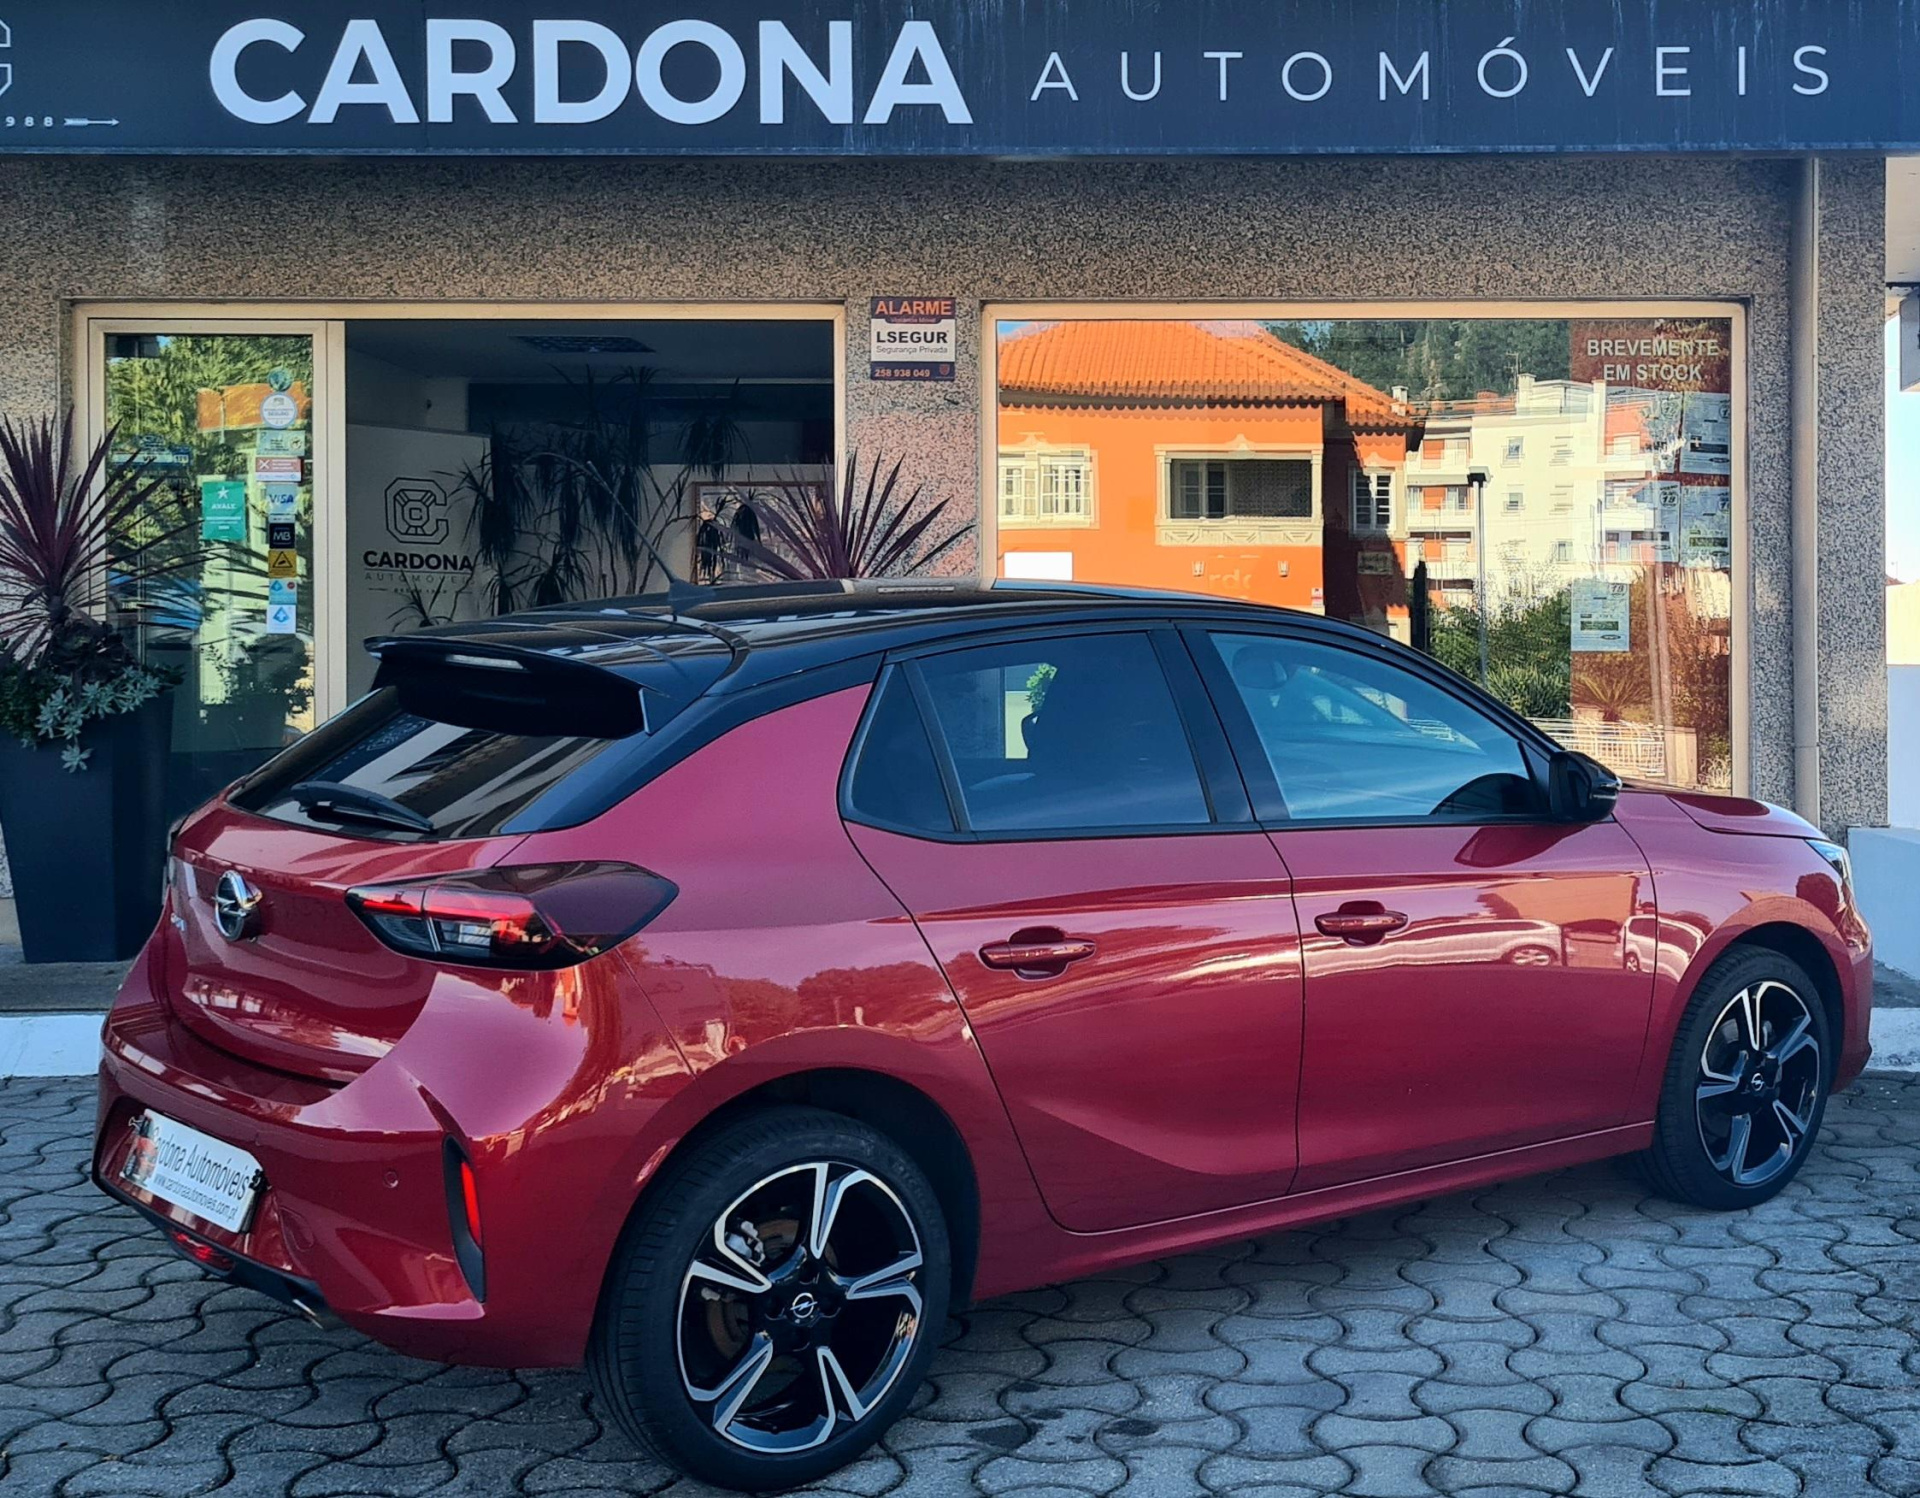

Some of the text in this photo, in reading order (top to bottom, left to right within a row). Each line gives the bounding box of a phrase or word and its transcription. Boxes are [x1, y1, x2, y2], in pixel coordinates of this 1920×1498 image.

[210, 18, 1829, 125] CARDONA AUTOMÓVEIS
[875, 300, 952, 315] ALARME
[876, 331, 948, 344] LSEGUR
[876, 345, 948, 355] Segurança Privada
[1587, 339, 1720, 357] BREVEMENTE
[1603, 364, 1703, 381] EM STOCK
[268, 494, 294, 503] VISA
[273, 531, 291, 541] MB
[363, 550, 474, 571] CARDONA
[181, 1143, 250, 1200] Automóveis
